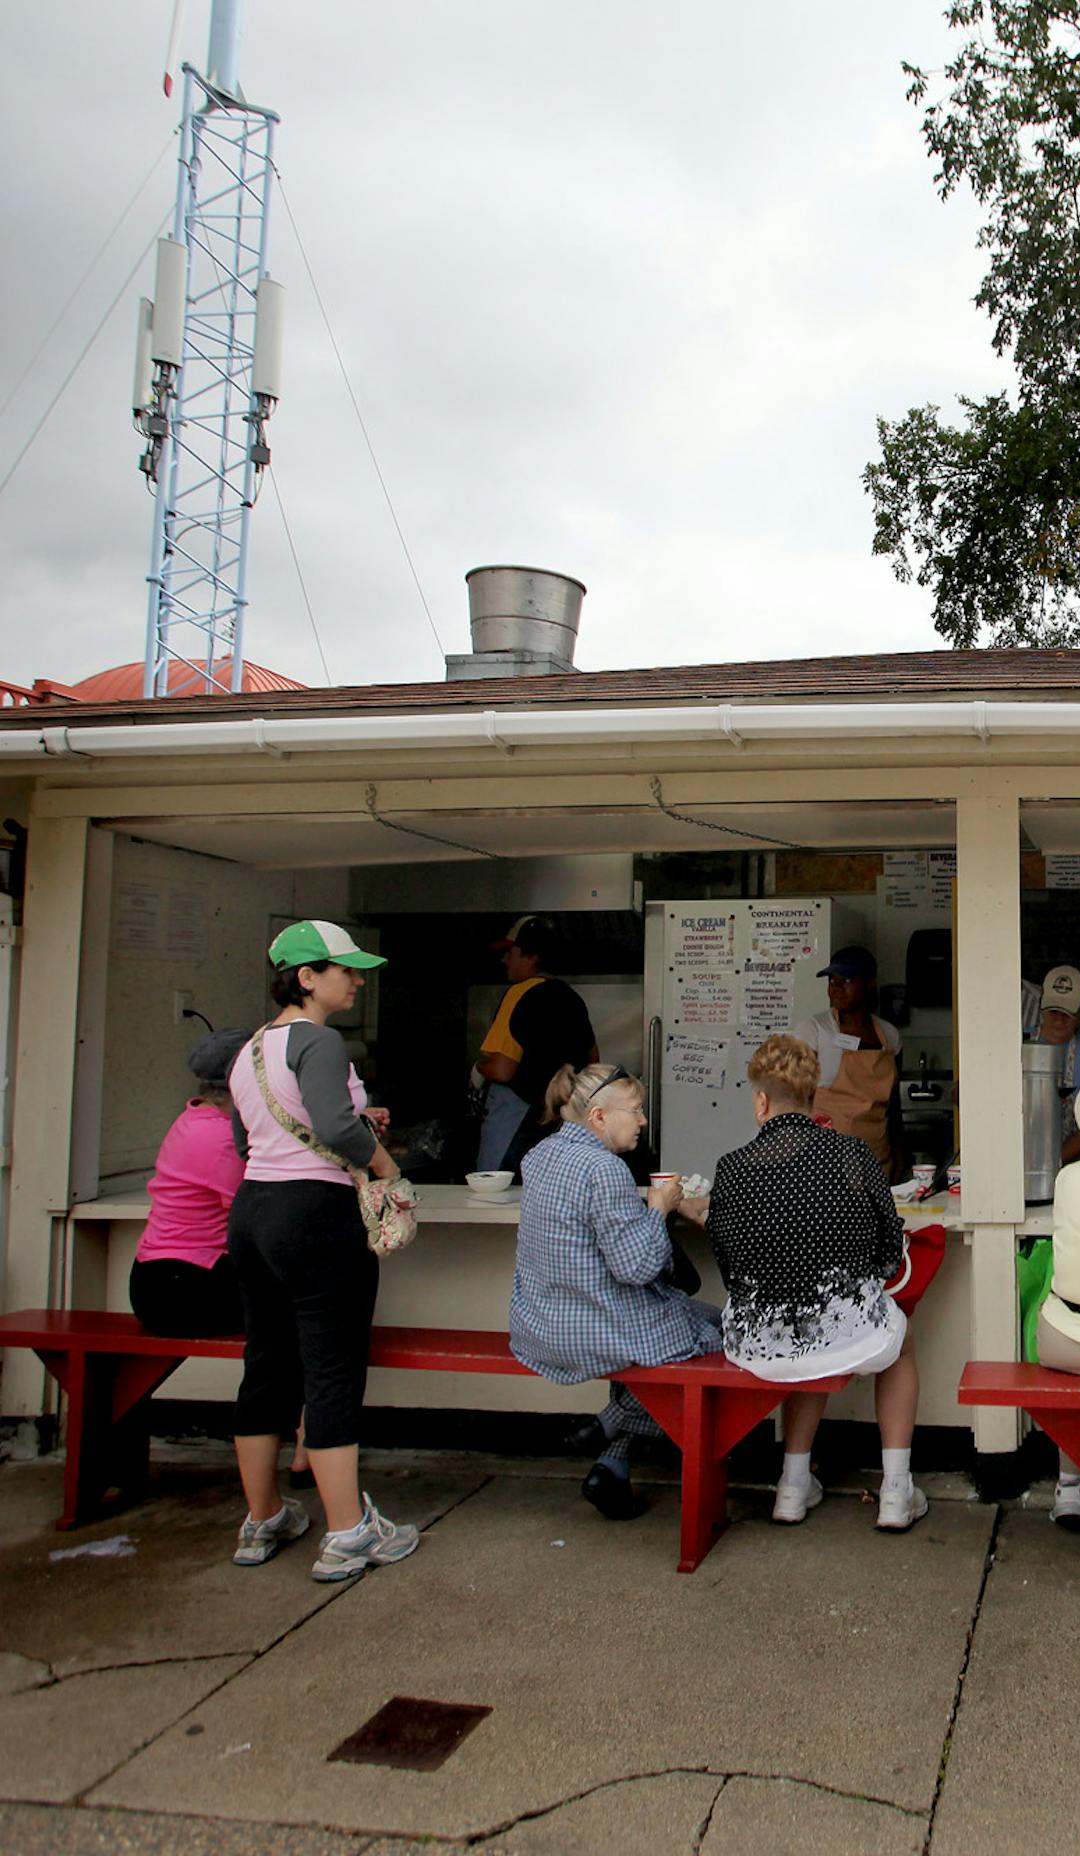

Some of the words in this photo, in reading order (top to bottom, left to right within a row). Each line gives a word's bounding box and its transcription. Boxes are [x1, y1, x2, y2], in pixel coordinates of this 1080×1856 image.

[751, 909, 815, 918] CONTINENTAL
[681, 918, 696, 928] ICE
[697, 918, 726, 929] CREAM
[755, 921, 810, 929] BREAKFAST
[744, 962, 791, 972] BEVERAGES
[672, 1040, 718, 1053] SWEDISH
[682, 1053, 705, 1063] EGG
[672, 1063, 713, 1075] COFFEE
[674, 1073, 704, 1084] $1.00
